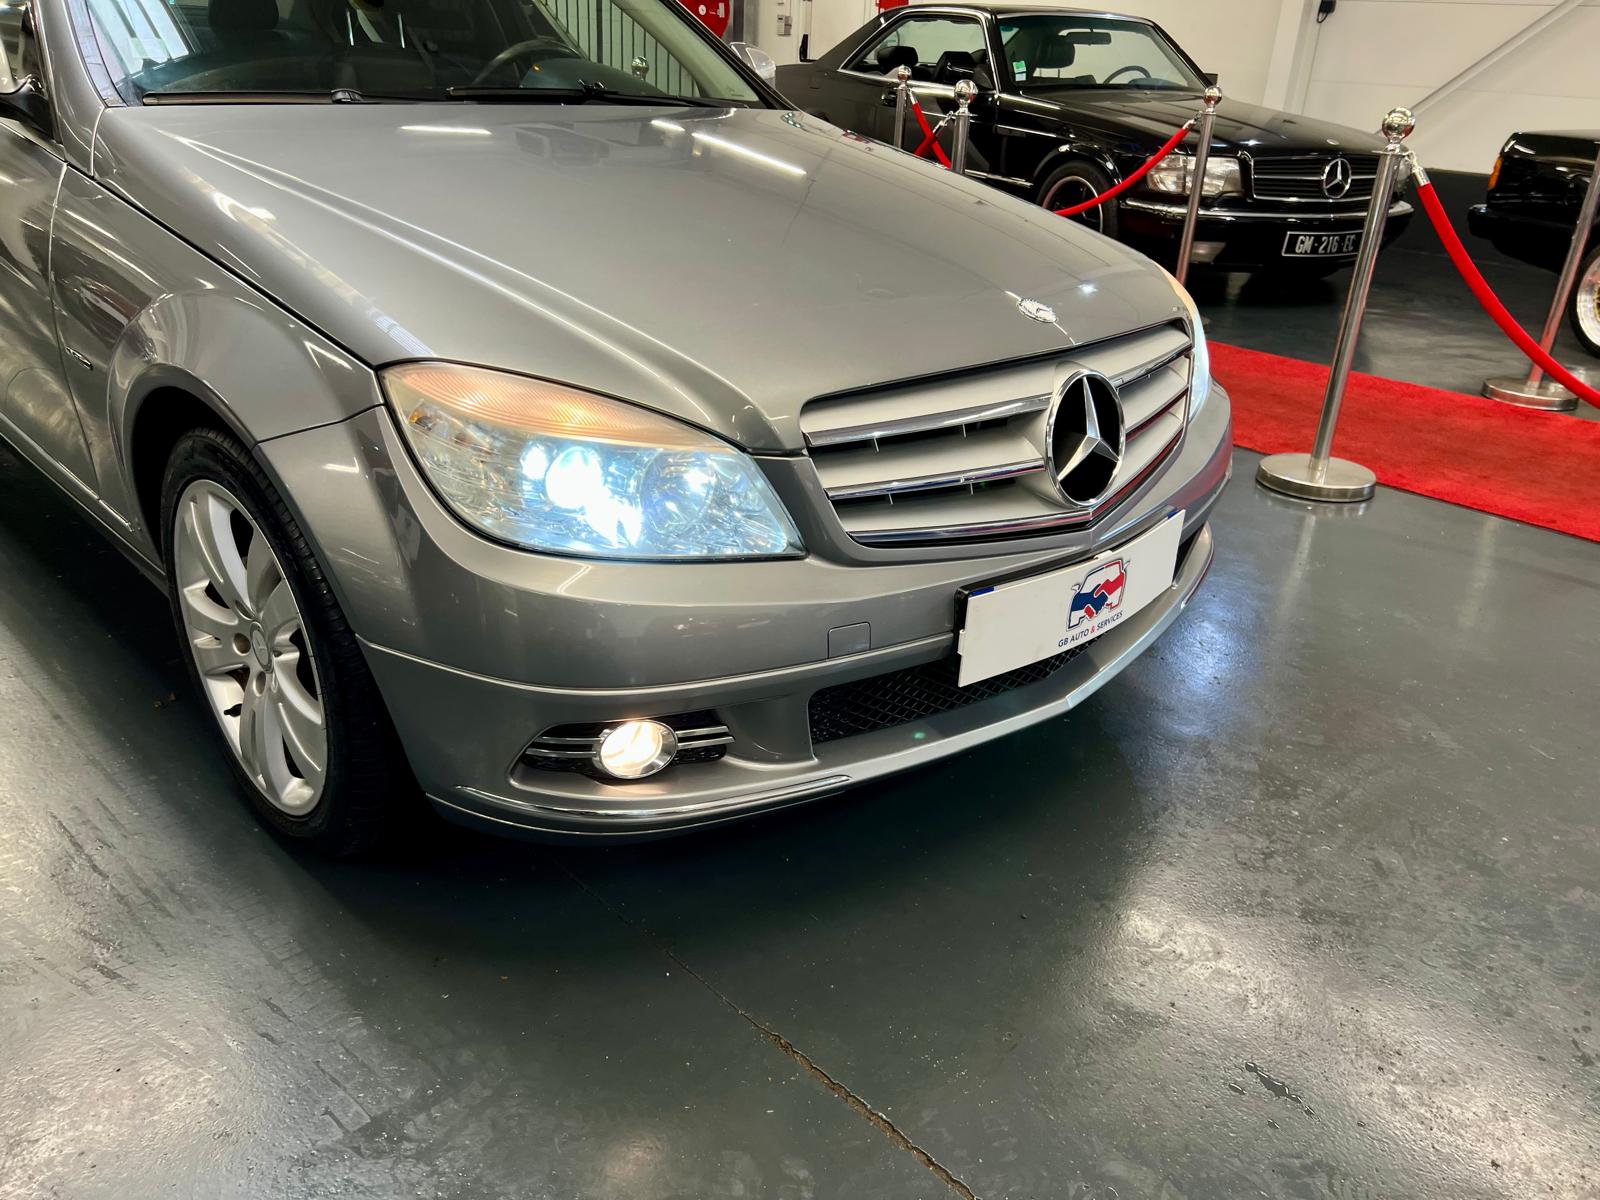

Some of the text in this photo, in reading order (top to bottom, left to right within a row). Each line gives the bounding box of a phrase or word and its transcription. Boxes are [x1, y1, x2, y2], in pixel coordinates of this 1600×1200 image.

[1058, 637, 1069, 647] GB
[1070, 628, 1089, 643] AUTO
[1096, 610, 1123, 631] SERVICES
